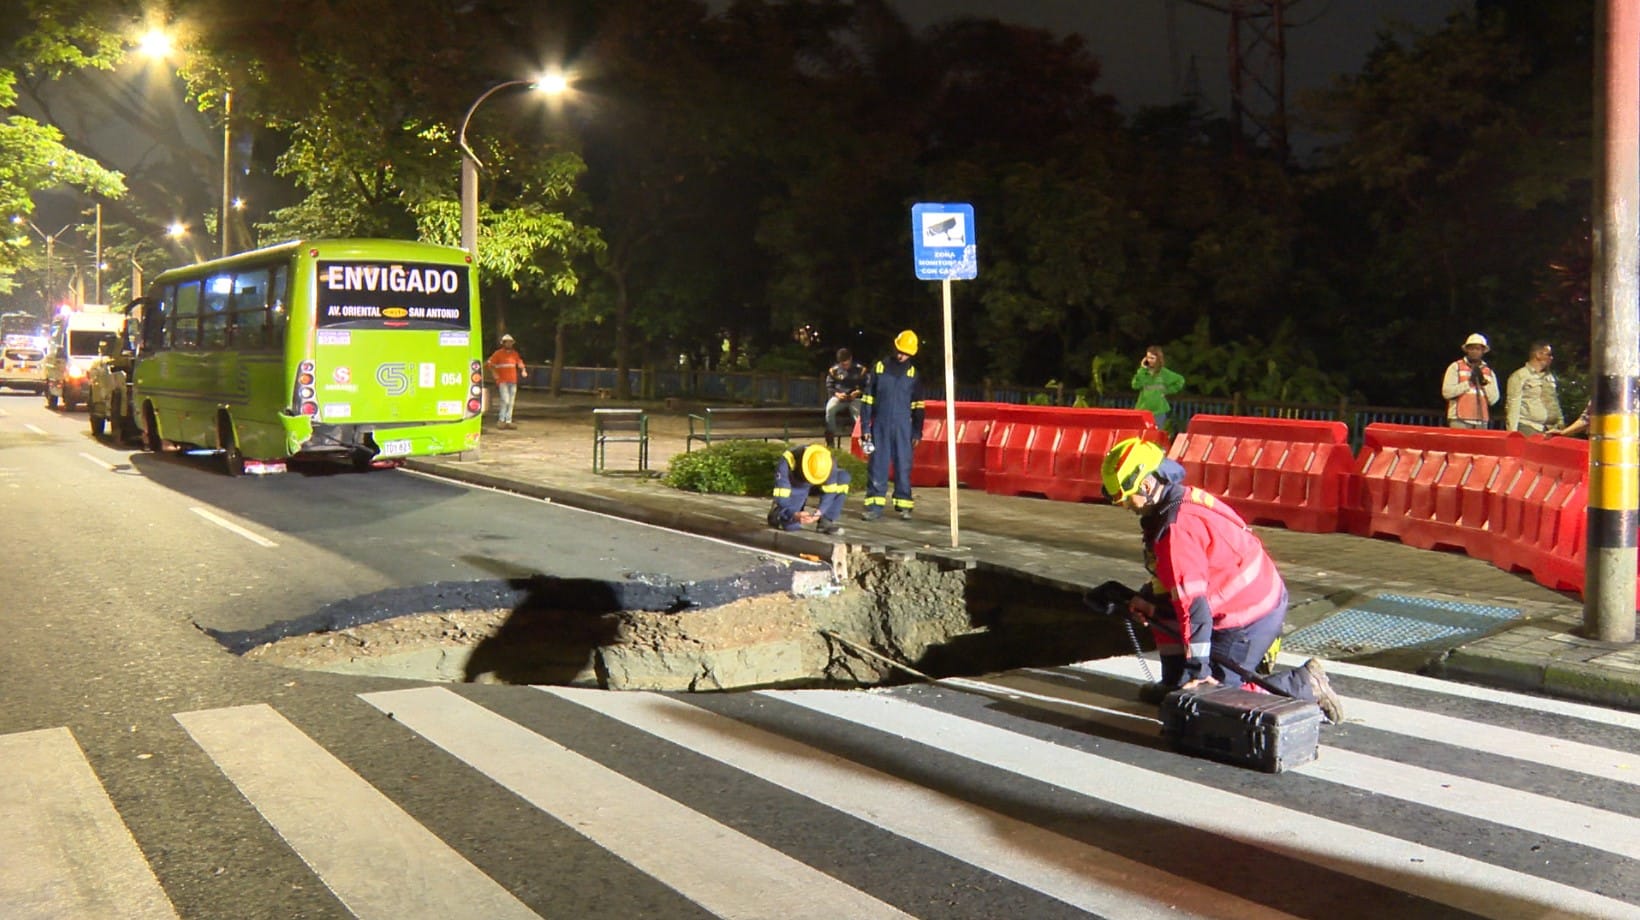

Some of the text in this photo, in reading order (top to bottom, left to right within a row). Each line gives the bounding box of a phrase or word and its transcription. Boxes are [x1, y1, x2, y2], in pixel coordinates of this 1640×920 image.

[328, 265, 459, 294] ENVIGADO
[328, 306, 341, 317] AV.
[342, 305, 382, 318] ORIENTAL
[409, 307, 425, 318] SAN
[426, 308, 460, 320] ANTONIO
